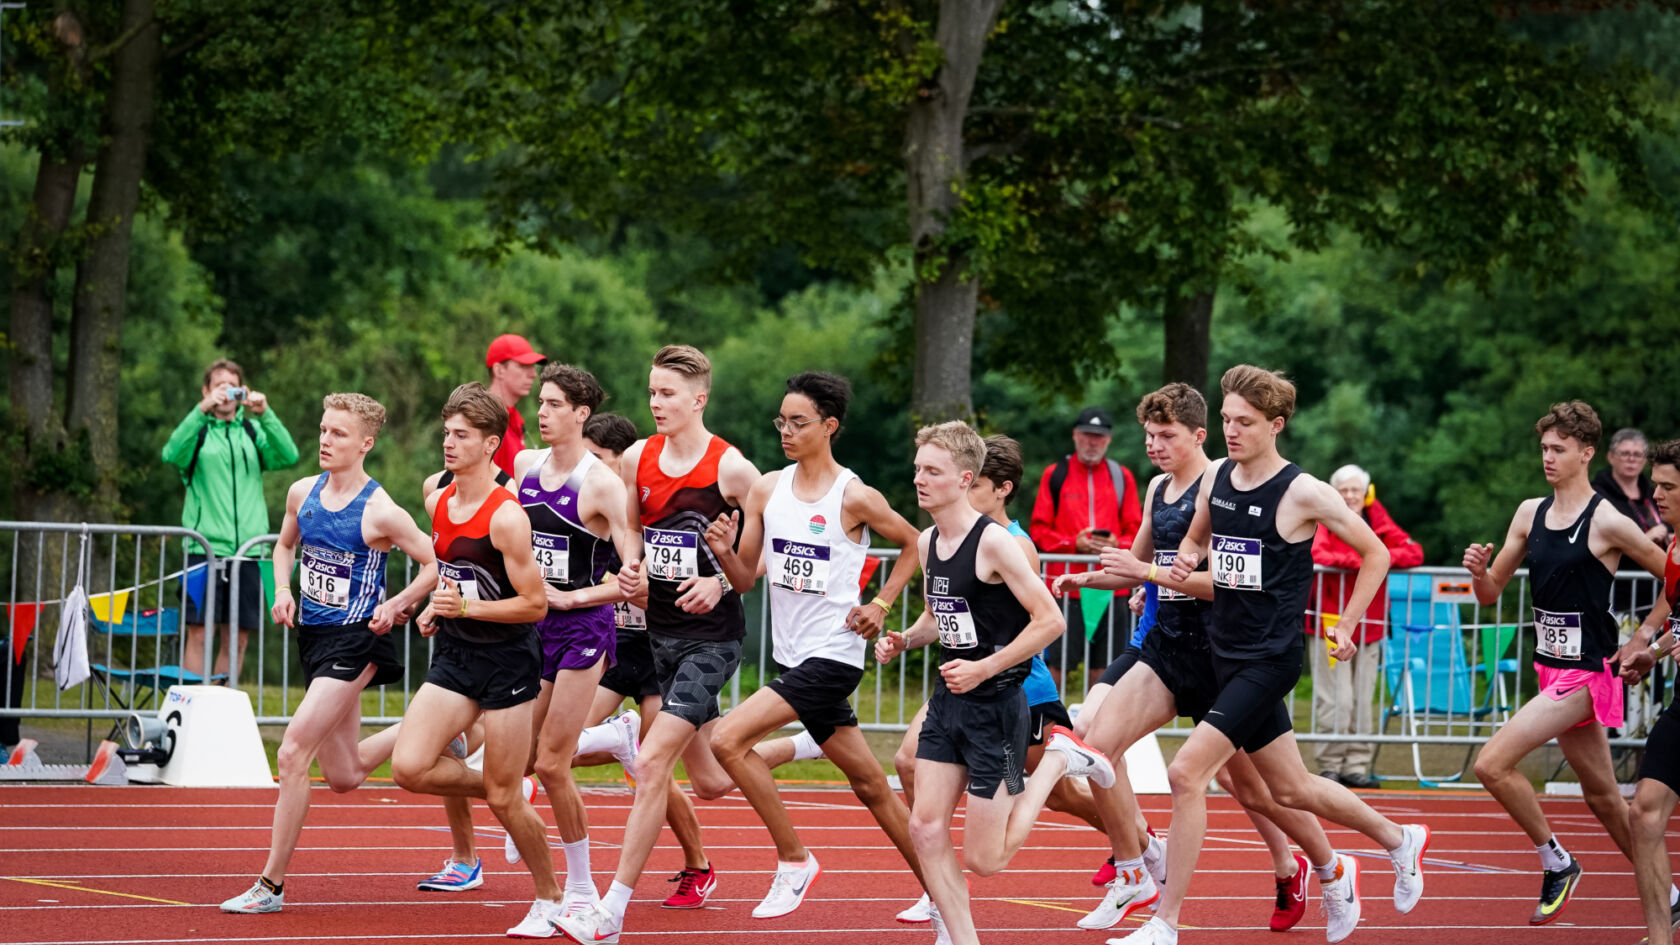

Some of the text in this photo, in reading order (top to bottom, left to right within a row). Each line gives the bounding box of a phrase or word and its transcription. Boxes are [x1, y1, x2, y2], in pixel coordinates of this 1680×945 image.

[535, 537, 555, 548] asics
[660, 534, 683, 545] asics
[791, 545, 816, 557] asics
[1225, 541, 1246, 552] asics
[532, 547, 554, 567] 43
[652, 546, 682, 566] 794
[315, 562, 337, 575] asics
[783, 557, 814, 578] 469
[1218, 553, 1245, 573] 190
[308, 571, 335, 593] 616
[938, 601, 955, 611] asics
[1546, 615, 1566, 626] asics
[1542, 626, 1568, 644] 285
